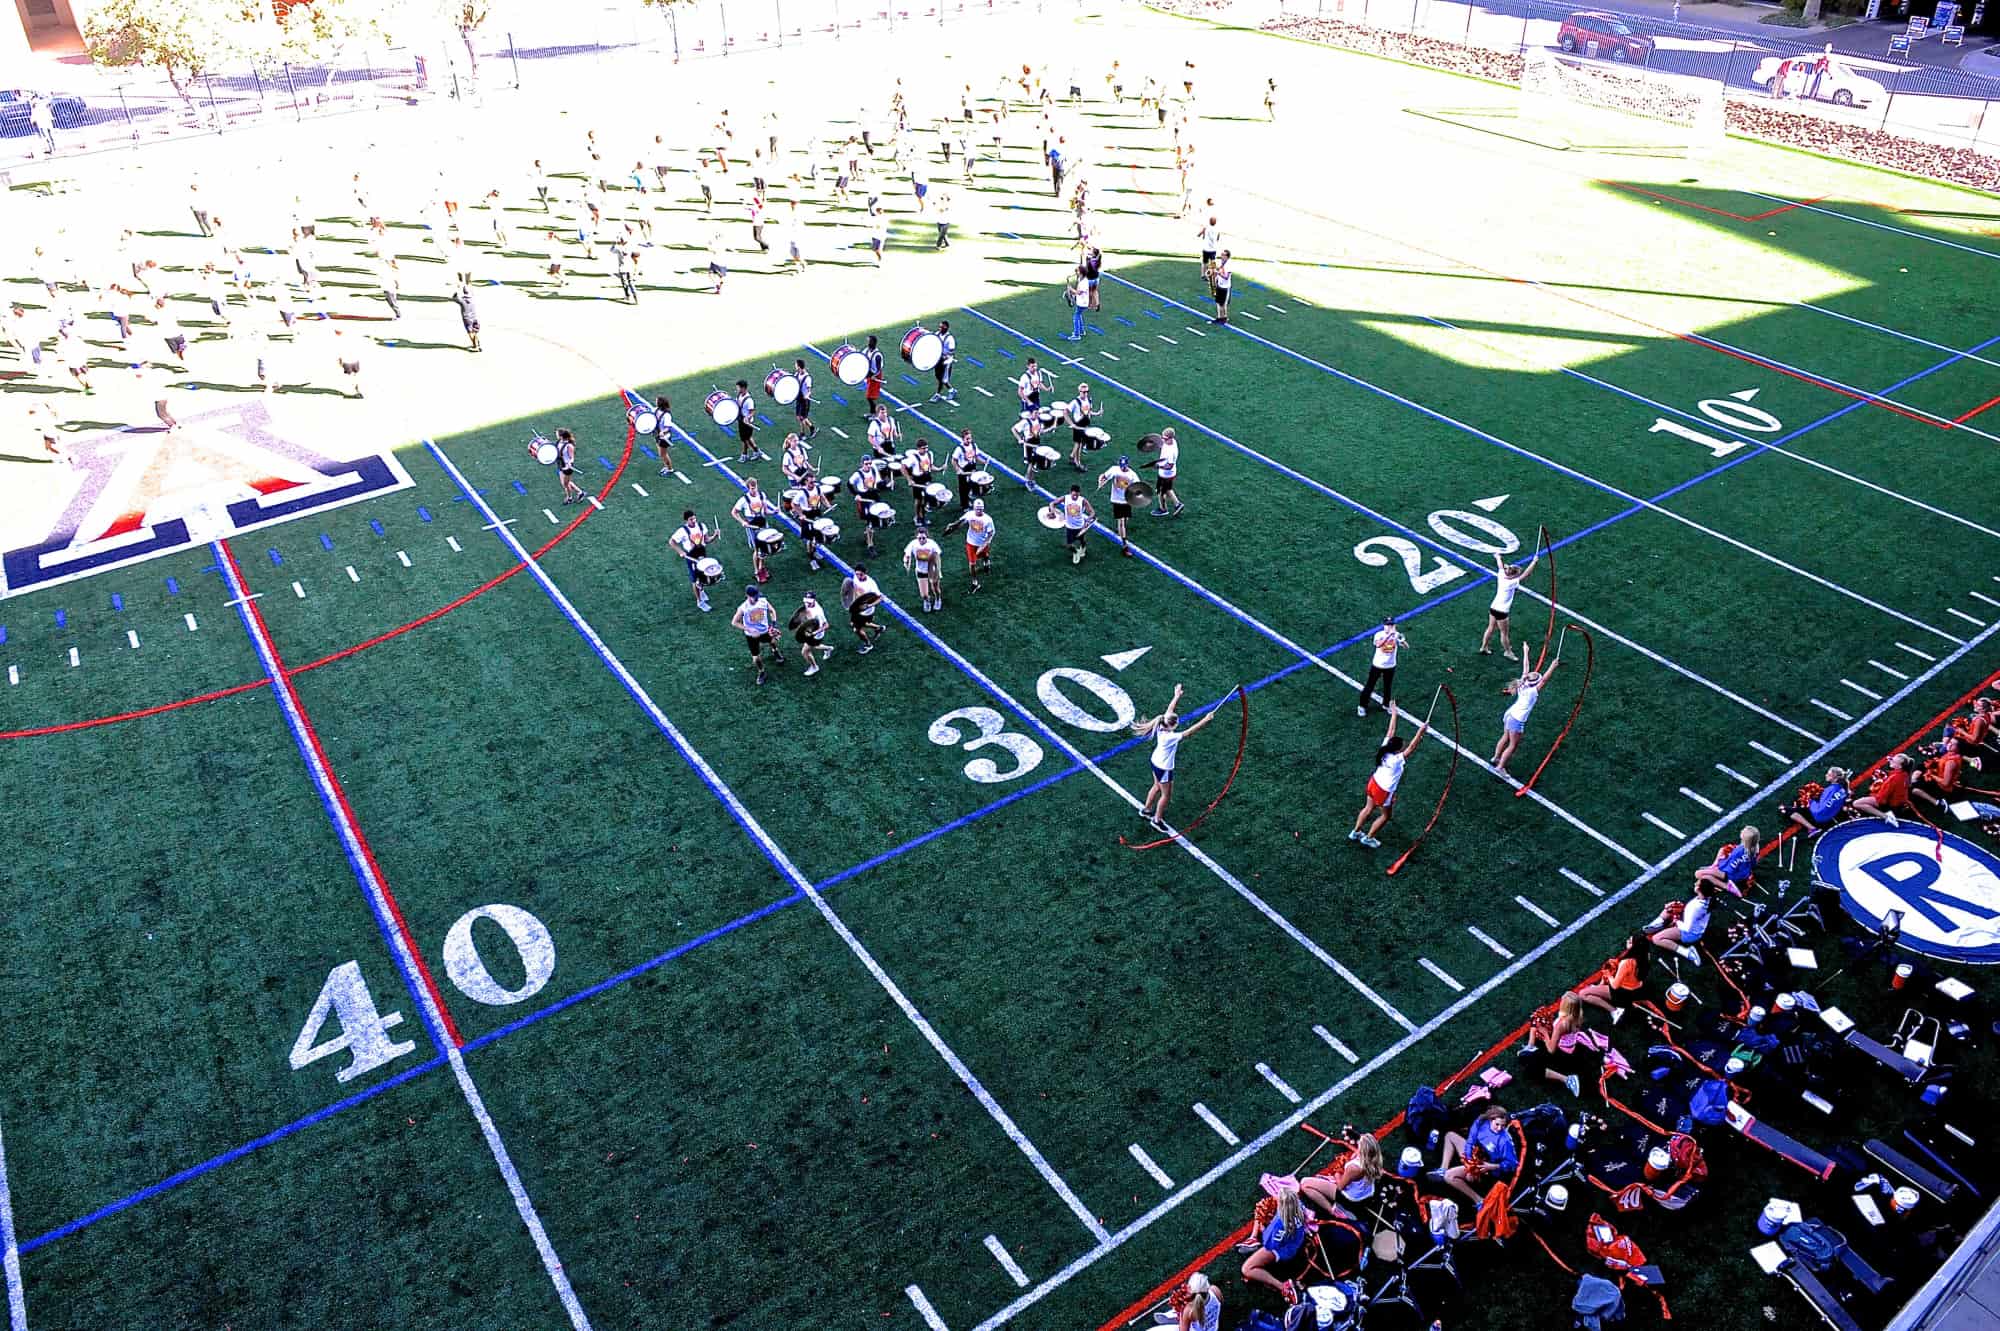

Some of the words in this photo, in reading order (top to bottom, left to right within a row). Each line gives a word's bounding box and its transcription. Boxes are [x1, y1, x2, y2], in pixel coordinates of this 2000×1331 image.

[1648, 399, 1782, 457] 10
[1353, 510, 1520, 595] 20
[928, 667, 1136, 784] 30
[1858, 851, 2000, 933] R
[289, 903, 556, 1082] 40
[1619, 1187, 1641, 1209] 40
